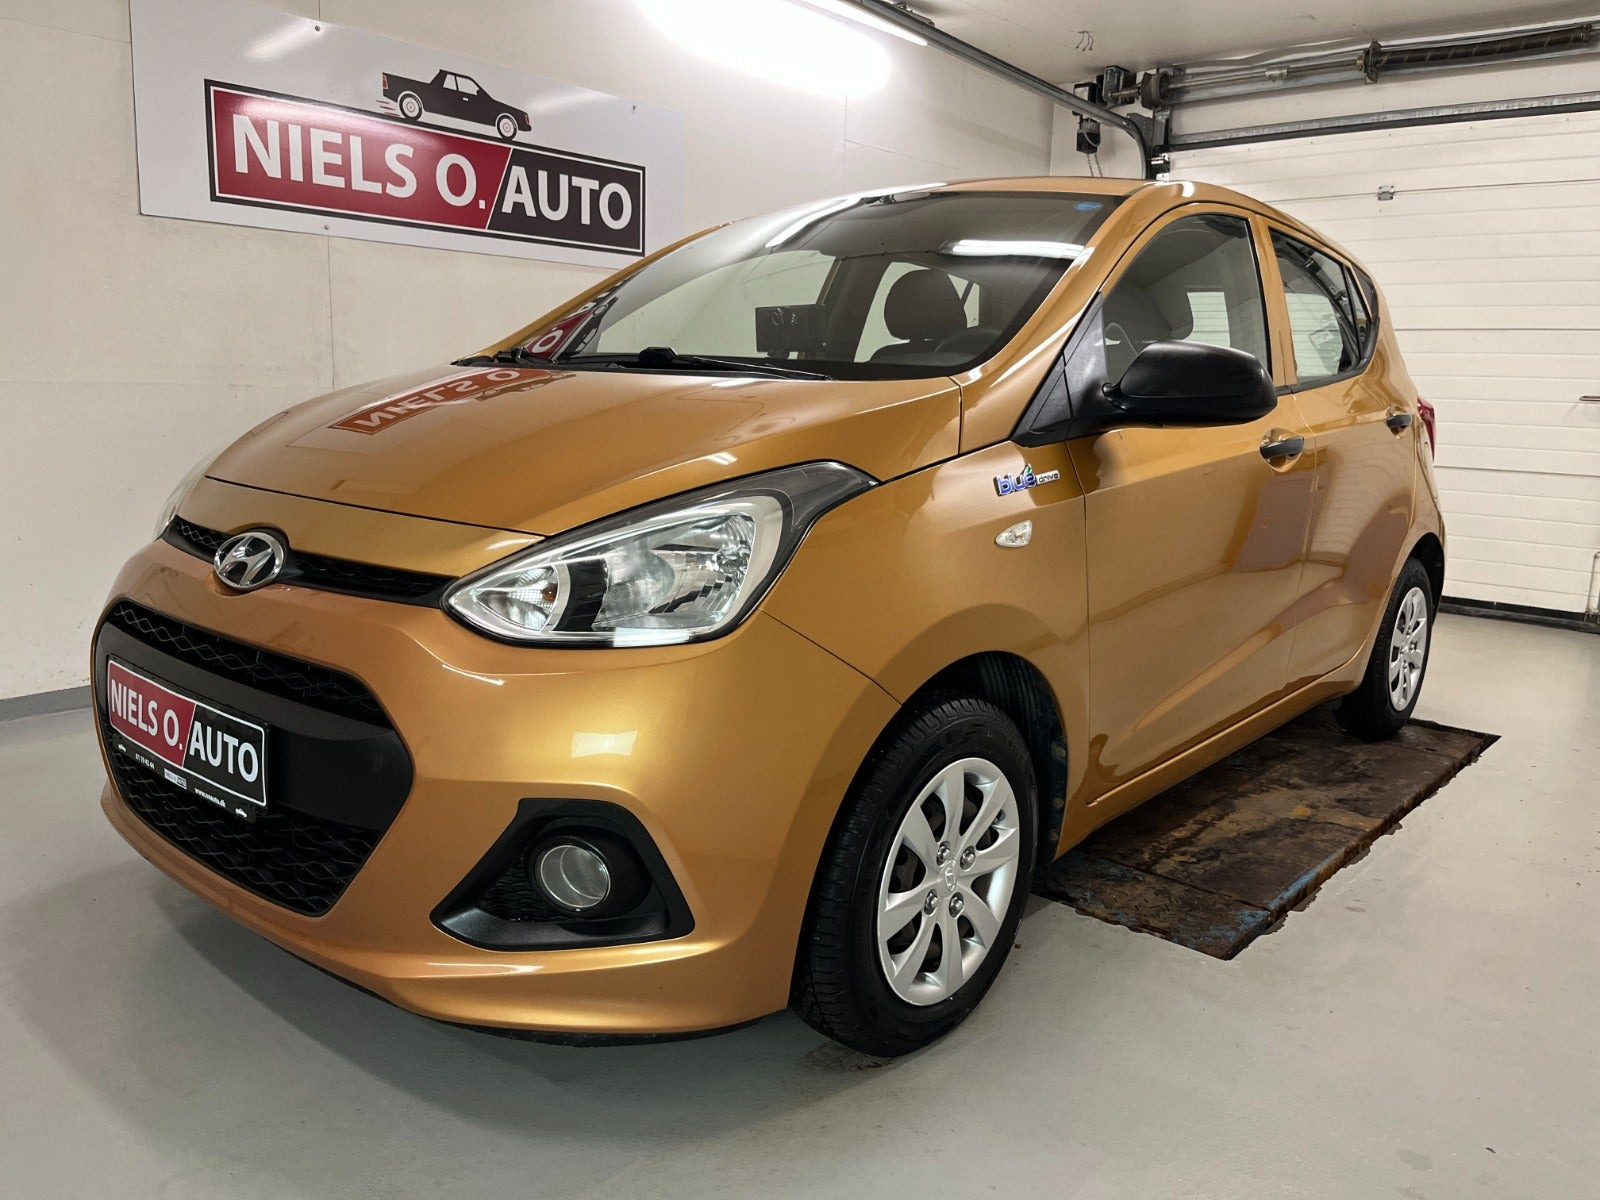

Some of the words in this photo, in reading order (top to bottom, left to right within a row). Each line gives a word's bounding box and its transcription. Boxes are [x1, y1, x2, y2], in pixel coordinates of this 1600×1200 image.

[233, 114, 417, 199] NIELS
[435, 153, 486, 210] O.
[501, 165, 632, 230] AUTO
[995, 472, 1036, 496] blue
[1038, 472, 1059, 484] drive
[111, 679, 158, 736] NIELS
[163, 709, 183, 750] O.
[189, 720, 259, 783] AUTO
